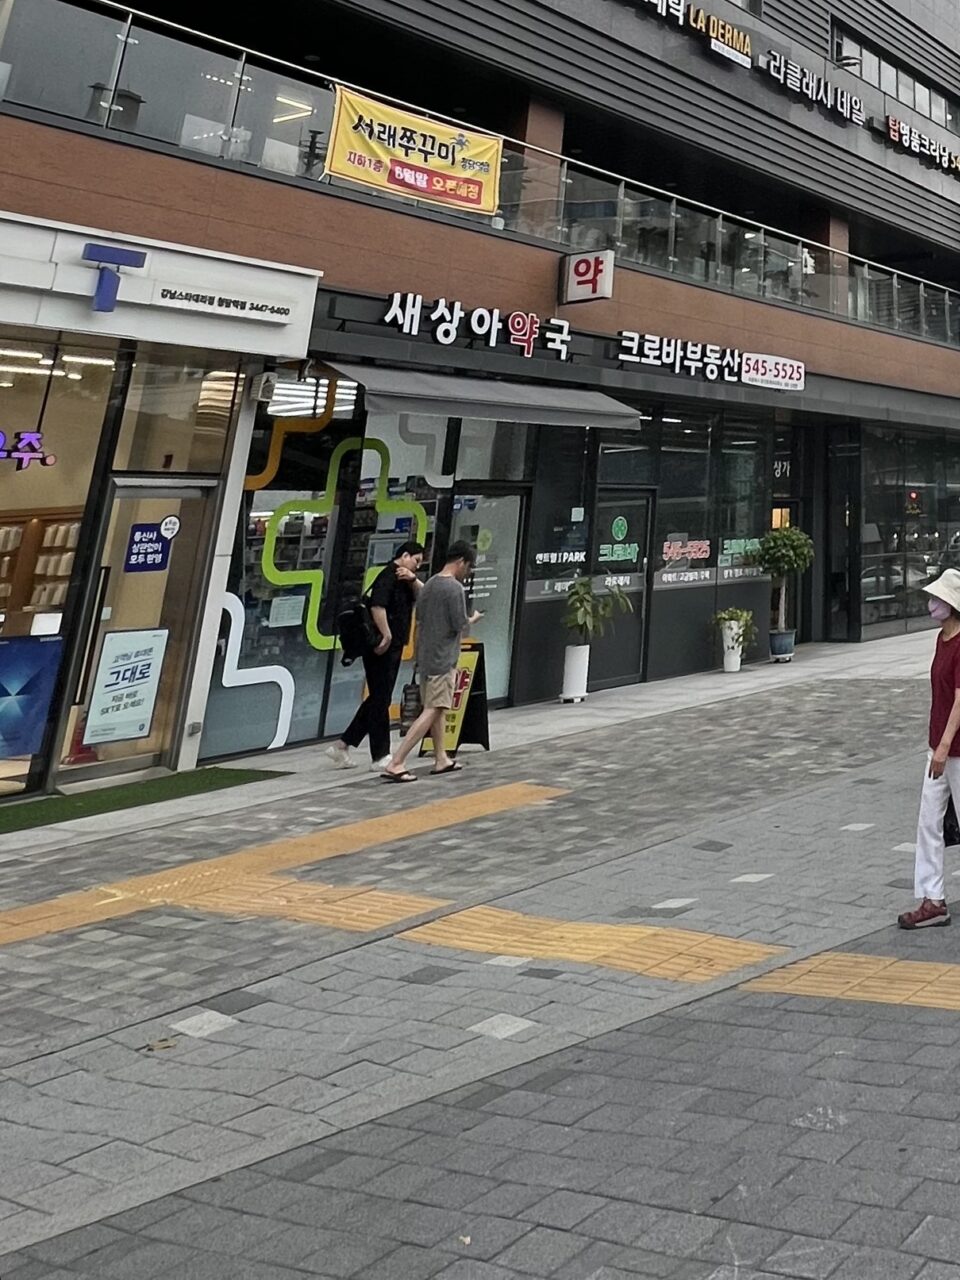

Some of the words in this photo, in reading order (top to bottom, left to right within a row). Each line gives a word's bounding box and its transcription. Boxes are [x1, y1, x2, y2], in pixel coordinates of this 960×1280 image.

[688, 3, 706, 33] LA
[708, 13, 753, 58] DERMA
[768, 49, 832, 110] 라클래시
[836, 85, 867, 127] 네일
[352, 114, 456, 167] 서래쭈꾸미
[573, 256, 604, 295] 약
[618, 330, 742, 383] 크로바부동산
[743, 356, 803, 382] 545-5525
[773, 460, 791, 478] 상가
[104, 662, 152, 688] 그대로
